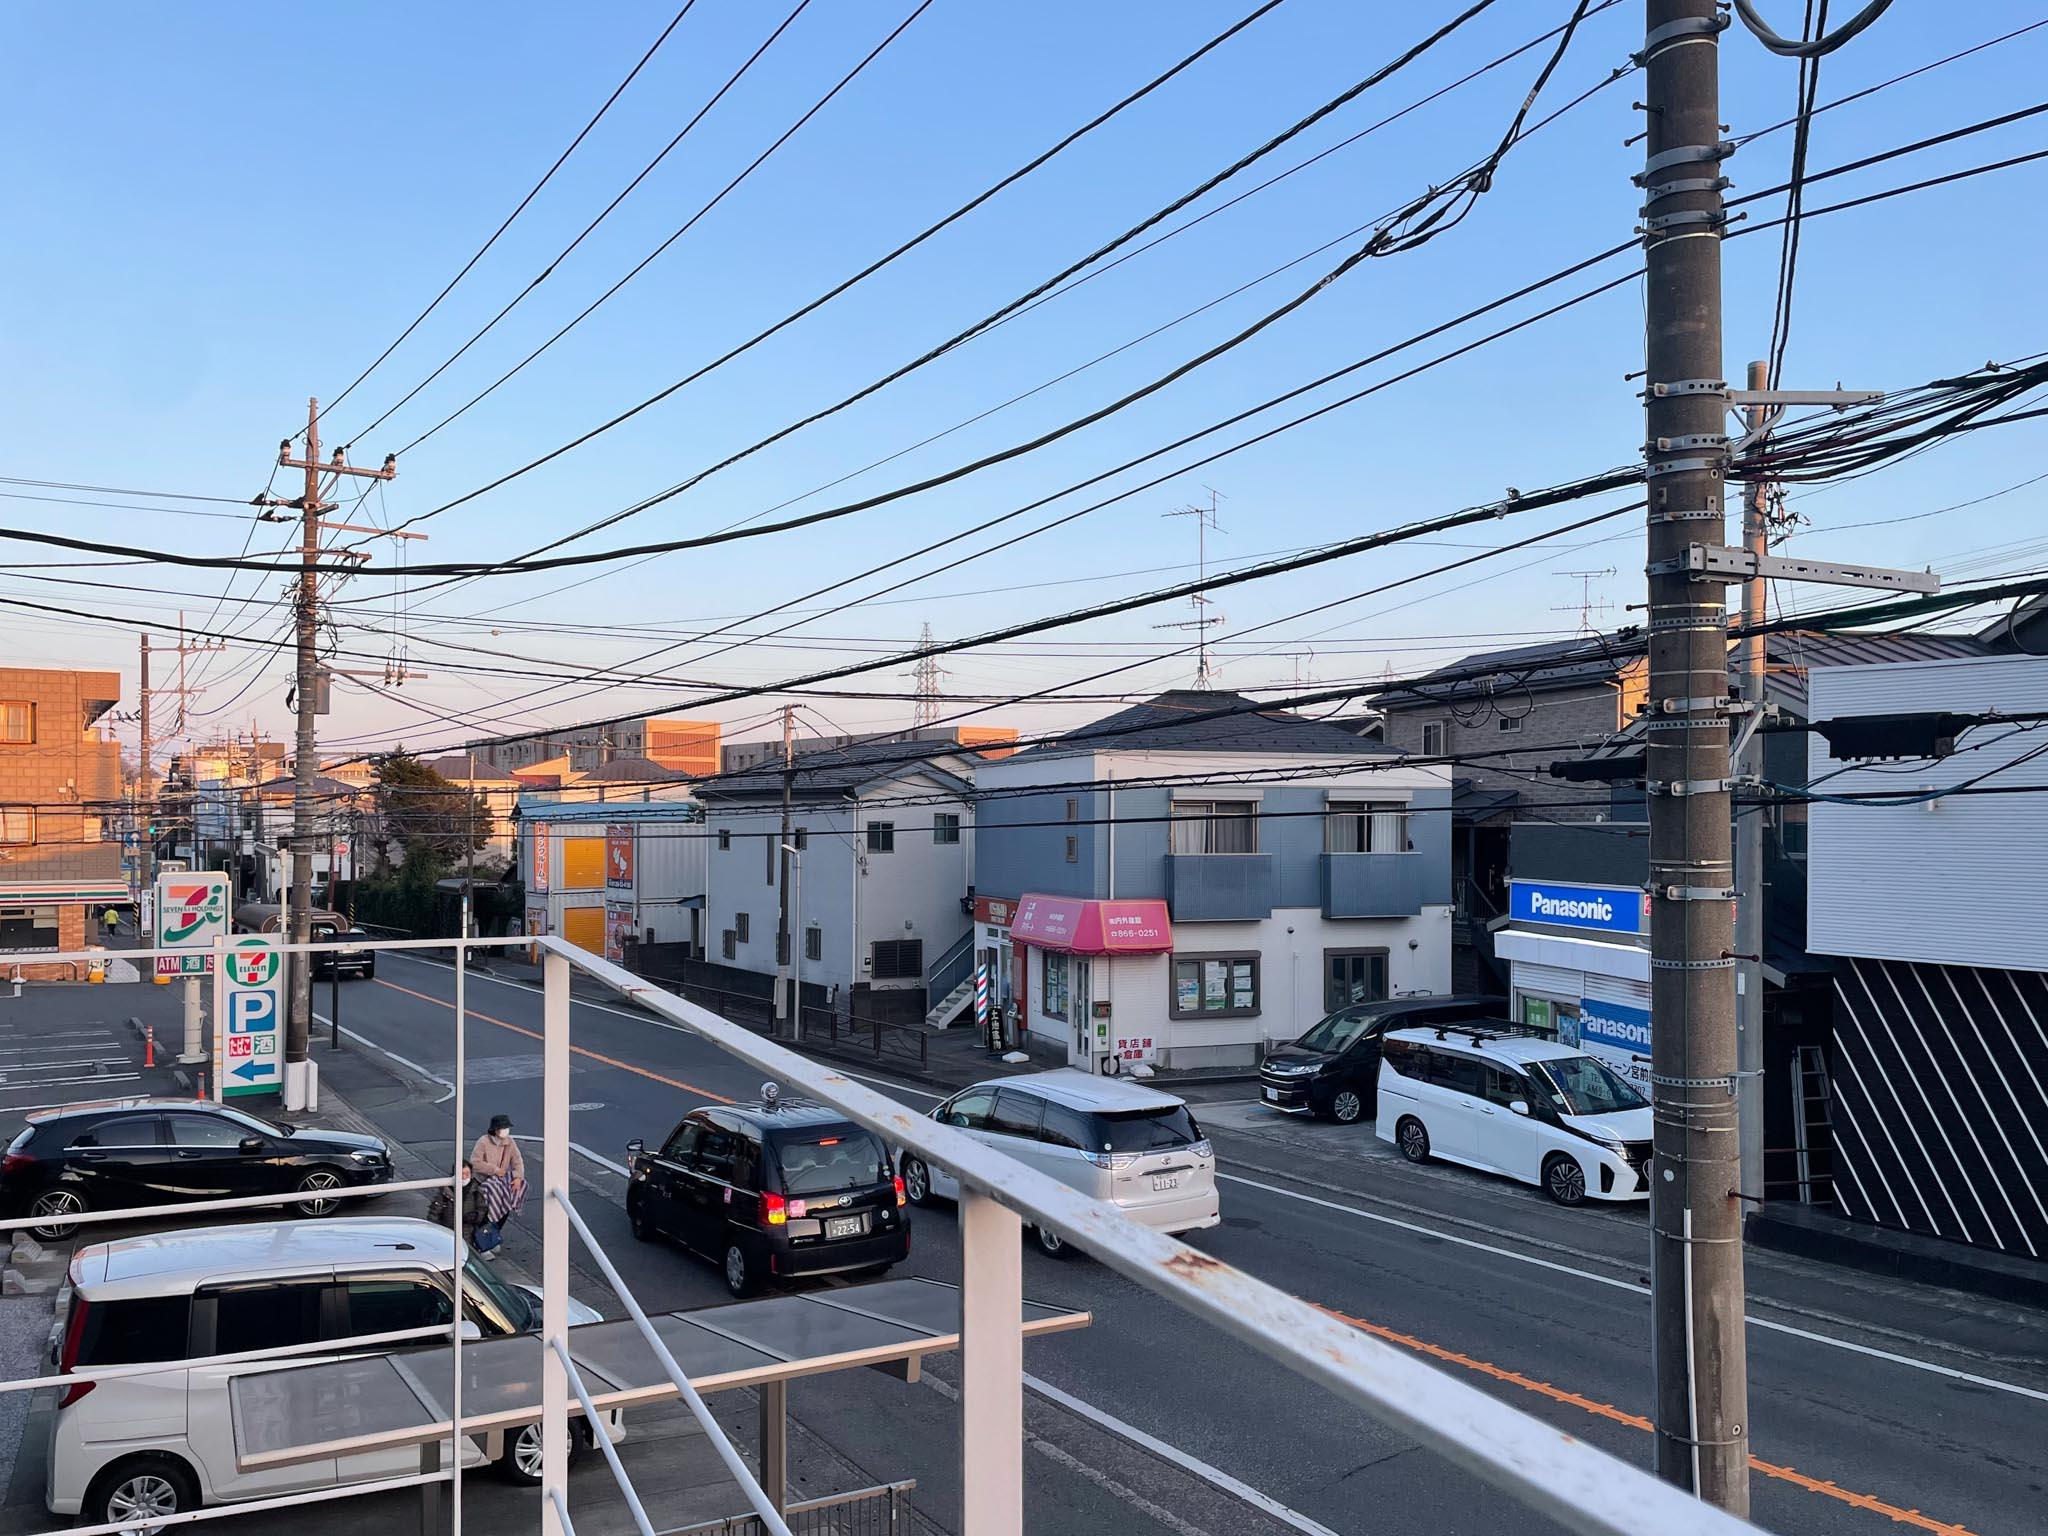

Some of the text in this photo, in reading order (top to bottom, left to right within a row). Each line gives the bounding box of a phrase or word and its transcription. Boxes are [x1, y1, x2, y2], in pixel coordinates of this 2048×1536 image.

[192, 904, 224, 913] HOLDINGS
[1531, 892, 1612, 921] Panasonic
[158, 957, 180, 971] ATM
[186, 956, 201, 970] 酒
[235, 991, 273, 1032] P
[1580, 1008, 1651, 1045] Panasoni
[230, 1038, 251, 1055] たばこ
[255, 1036, 274, 1054] 酒
[837, 1223, 860, 1236] 22-54
